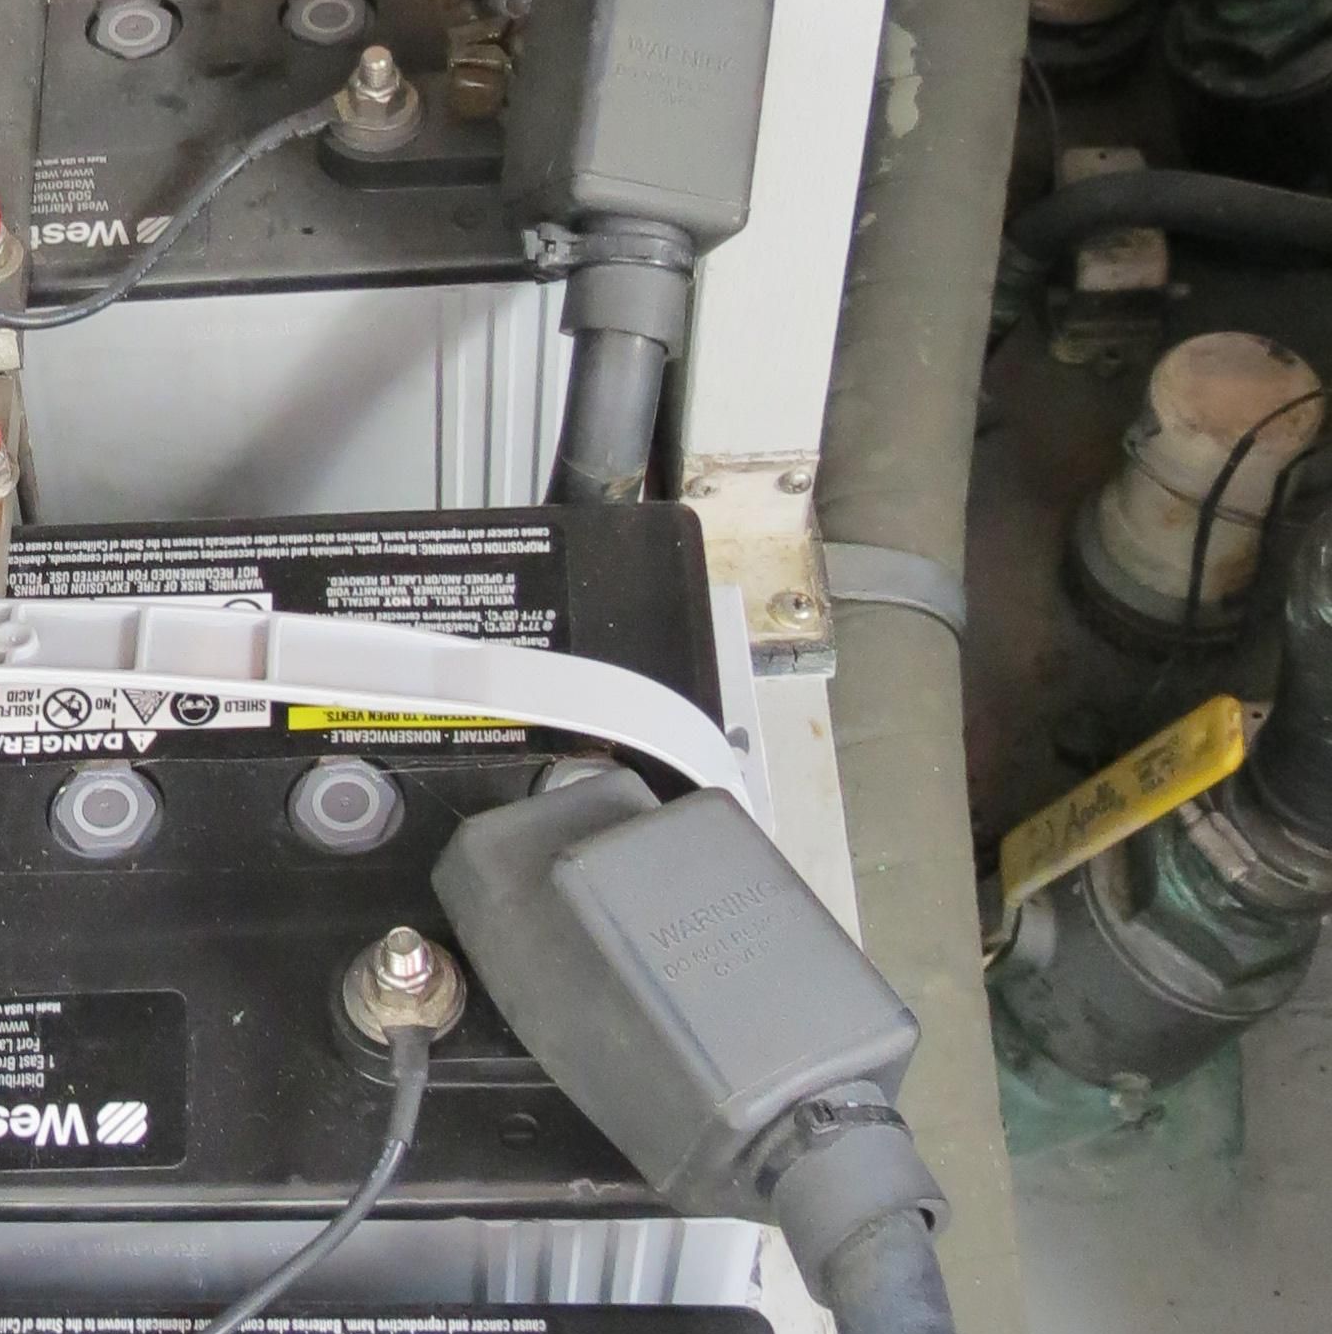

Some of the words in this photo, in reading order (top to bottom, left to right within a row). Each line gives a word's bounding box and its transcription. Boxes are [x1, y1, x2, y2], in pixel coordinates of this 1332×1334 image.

[77, 199, 108, 212] West
[30, 219, 129, 250] West
[310, 545, 353, 559] terminals
[383, 542, 416, 556] Battery
[484, 540, 550, 553] PROPOSITION
[72, 570, 124, 583] INVERTED
[126, 569, 148, 582] FOR
[150, 567, 234, 581] RECOMMENDED
[236, 566, 259, 579] NOT
[424, 574, 462, 585] AND/OR
[464, 573, 503, 584] OPENED
[180, 579, 206, 592] RISK
[208, 577, 263, 591] WARNING:
[393, 575, 422, 585] LABEL
[71, 581, 130, 595] EXPLOSION
[326, 587, 350, 597] VOID
[352, 586, 407, 597] WARRANTY
[470, 584, 516, 595] AIRTIGHT
[342, 597, 380, 607] INSTALL
[382, 596, 411, 607] NOT
[463, 595, 515, 606] VENTILATE
[6, 689, 35, 703] ACID
[94, 696, 112, 710] NO
[224, 698, 266, 714] SHIELD
[330, 729, 442, 744] NONSERVICEABLE
[452, 729, 526, 743] IMPORTANT
[649, 881, 777, 949] WARNING
[16, 1037, 40, 1052] Fort
[19, 1055, 44, 1069] East
[35, 1317, 63, 1334] State
[65, 1317, 83, 1333] the
[97, 1317, 134, 1334] known
[136, 1318, 192, 1334] chemicals
[292, 1318, 341, 1334] Batteries
[378, 1315, 446, 1334] reproductive
[449, 1319, 469, 1334] and
